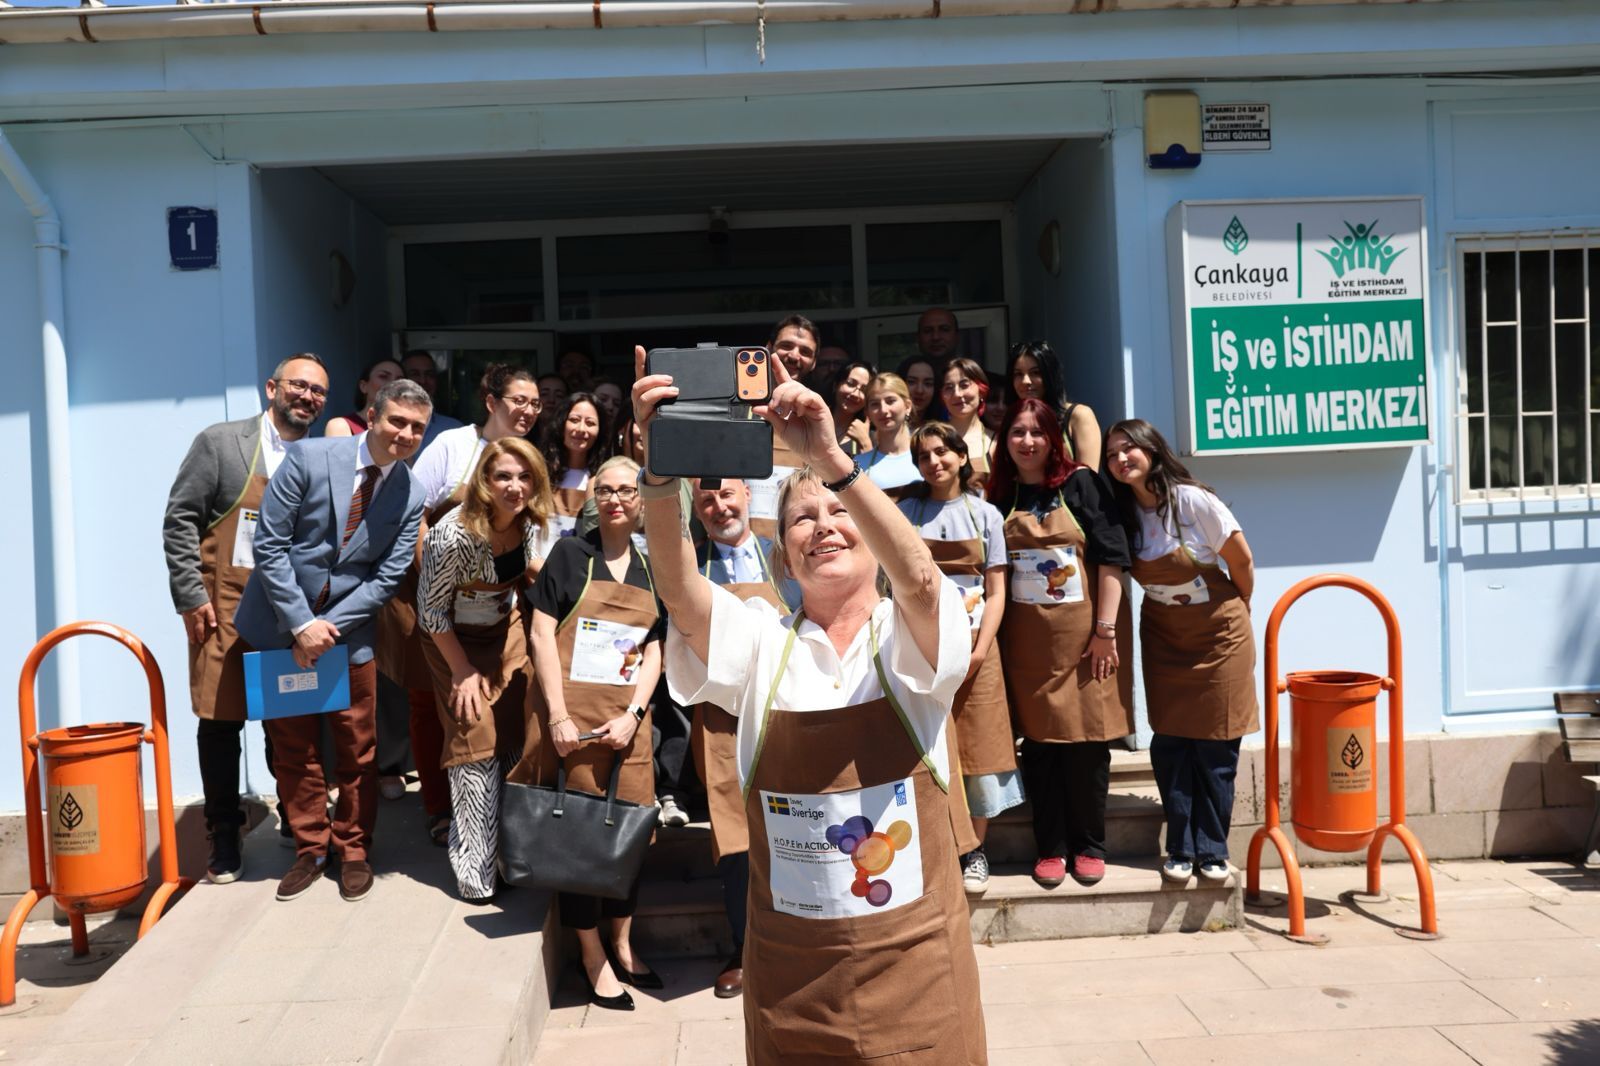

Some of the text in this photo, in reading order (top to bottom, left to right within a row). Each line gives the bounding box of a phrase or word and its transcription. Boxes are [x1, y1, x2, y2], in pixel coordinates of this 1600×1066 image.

[1232, 131, 1268, 140] GÜVENLİK
[187, 222, 197, 251] 1
[1194, 263, 1289, 288] Çankaya
[1357, 278, 1404, 287] İSTİHDAM
[1363, 286, 1407, 296] MERKEZİ
[1211, 313, 1414, 384] İŞ ve İSTİHDAM
[1206, 374, 1427, 440] EĞİTİM MERKEZİ
[792, 807, 824, 821] Sverige
[796, 840, 803, 850] in
[804, 842, 838, 851] ACTION
